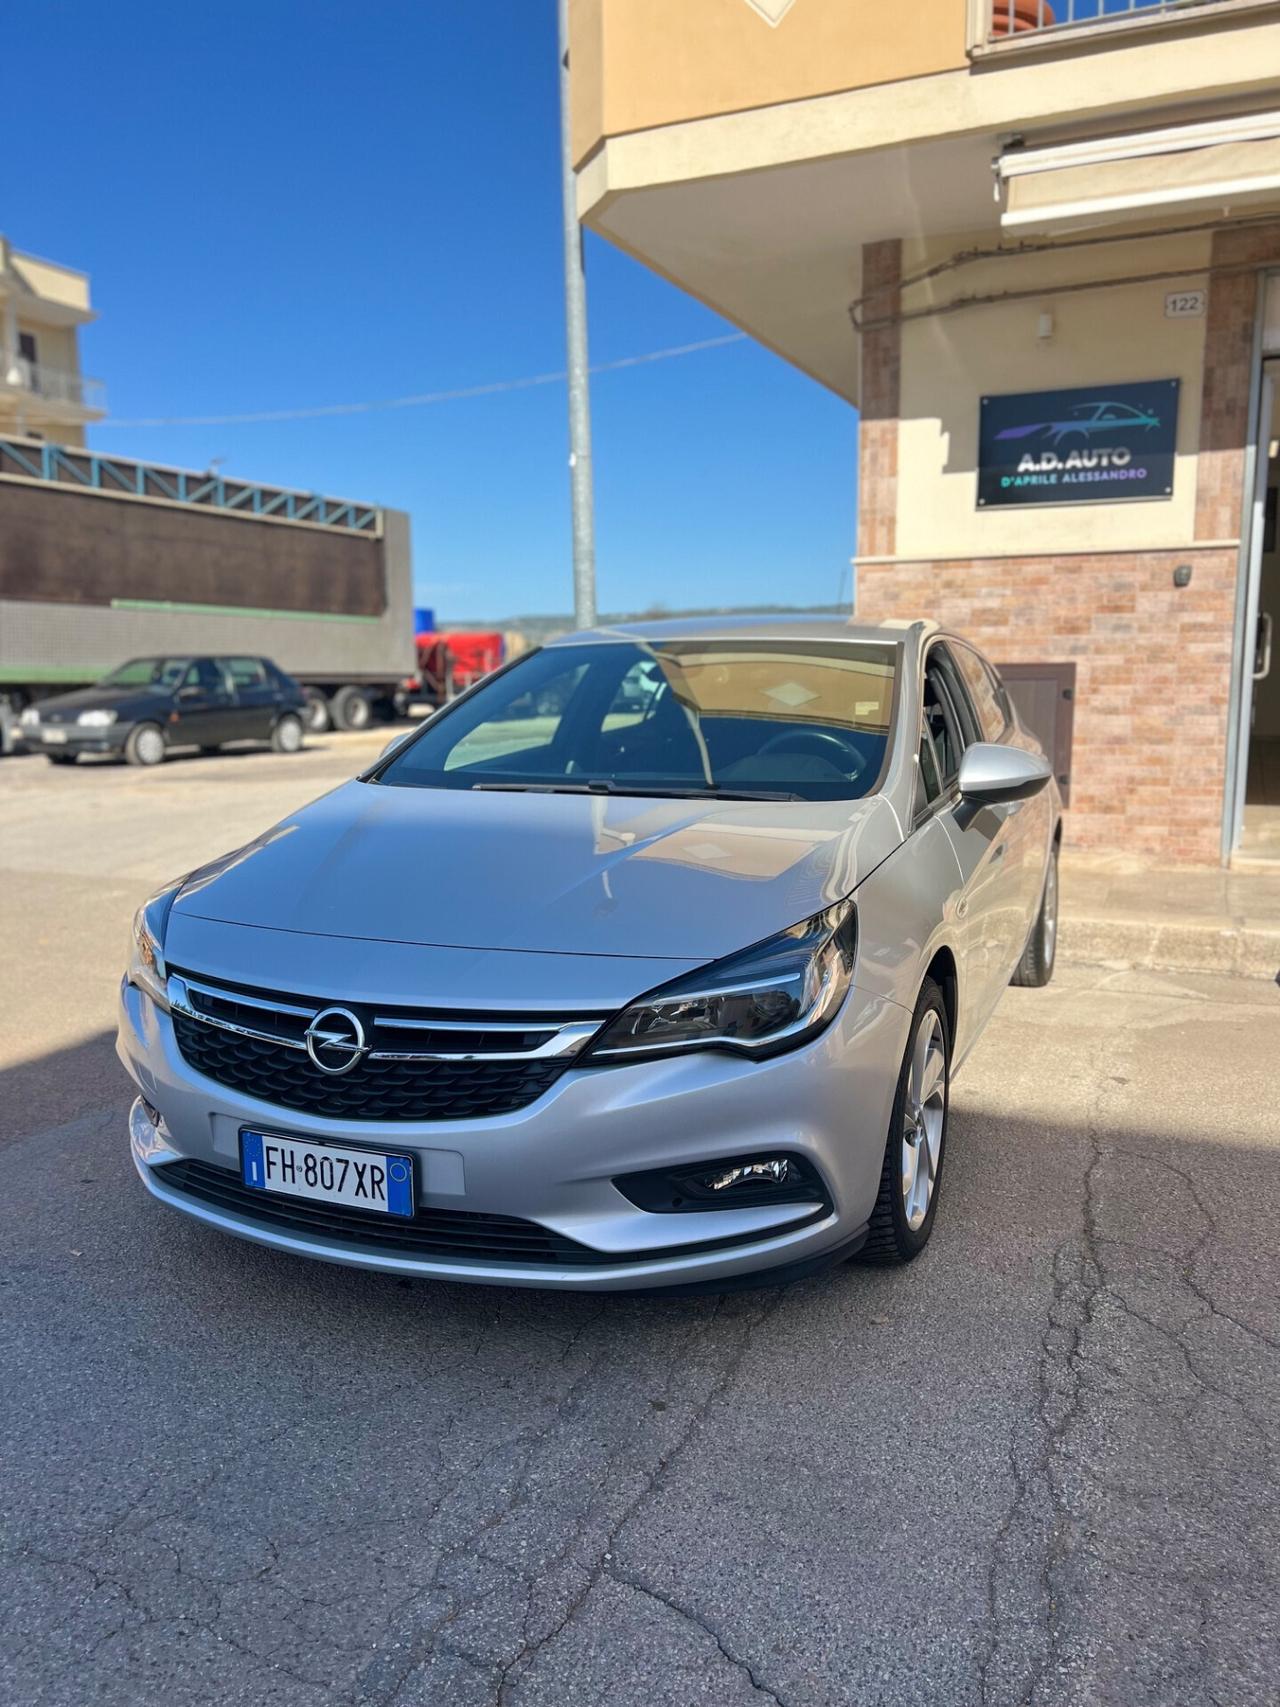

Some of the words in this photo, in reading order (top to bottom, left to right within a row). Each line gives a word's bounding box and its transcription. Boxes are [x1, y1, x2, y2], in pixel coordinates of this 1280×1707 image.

[1171, 296, 1199, 312] 122
[1001, 473, 1057, 487] D'APRILE
[1062, 468, 1147, 483] ALESSANDRO
